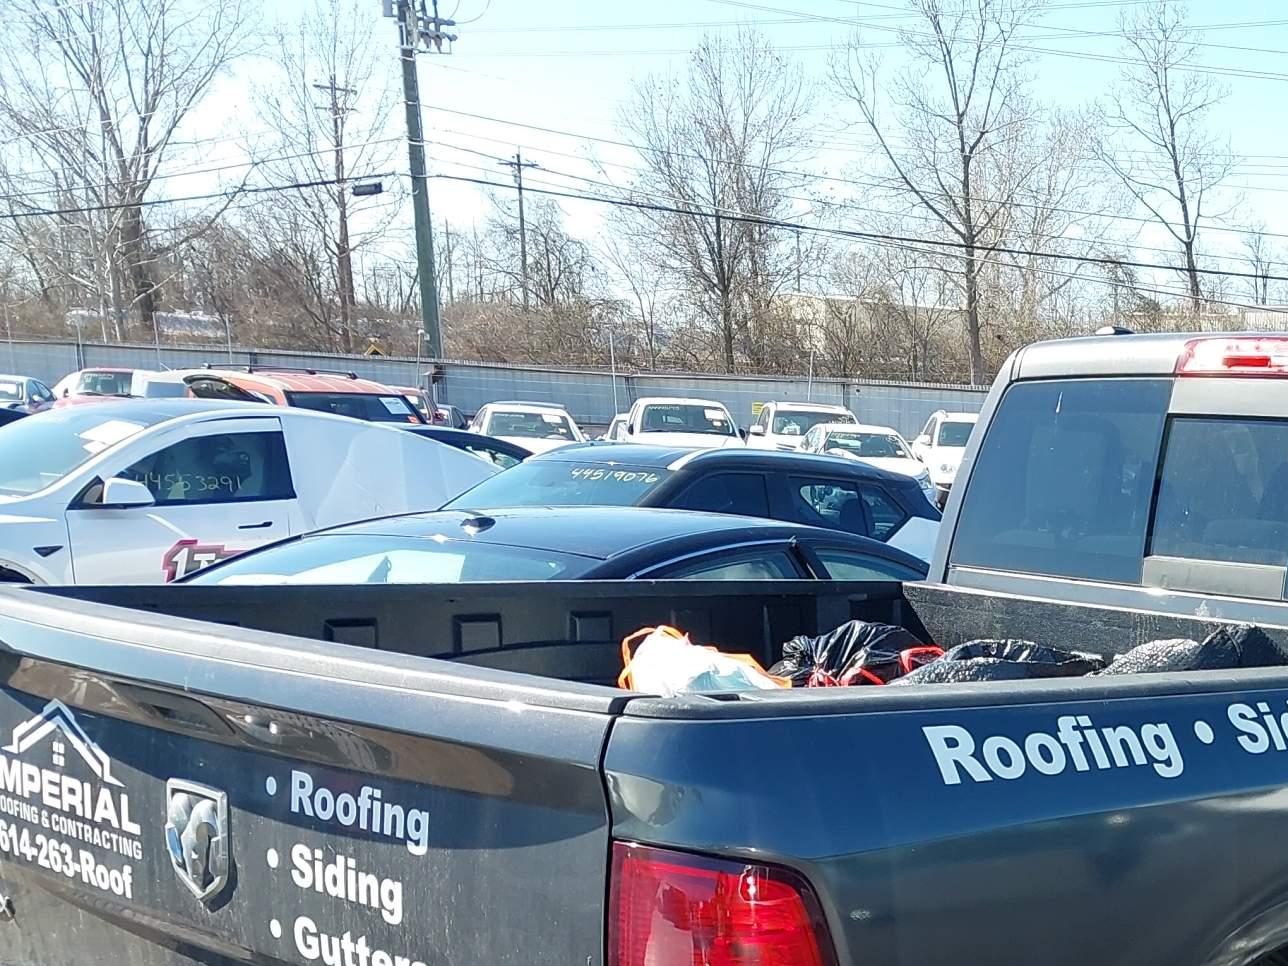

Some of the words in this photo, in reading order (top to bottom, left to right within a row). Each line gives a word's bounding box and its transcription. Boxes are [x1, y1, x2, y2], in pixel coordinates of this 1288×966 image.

[571, 467, 659, 483] 44519076
[922, 717, 1185, 785] Roofing
[0, 754, 141, 835] MPERIAL
[0, 794, 39, 824] OOFING
[41, 809, 50, 828] &
[51, 813, 143, 861] CONTRACTING
[289, 770, 431, 856] Roofing
[0, 818, 133, 899] 614-263-Roof
[290, 846, 404, 926] Siding
